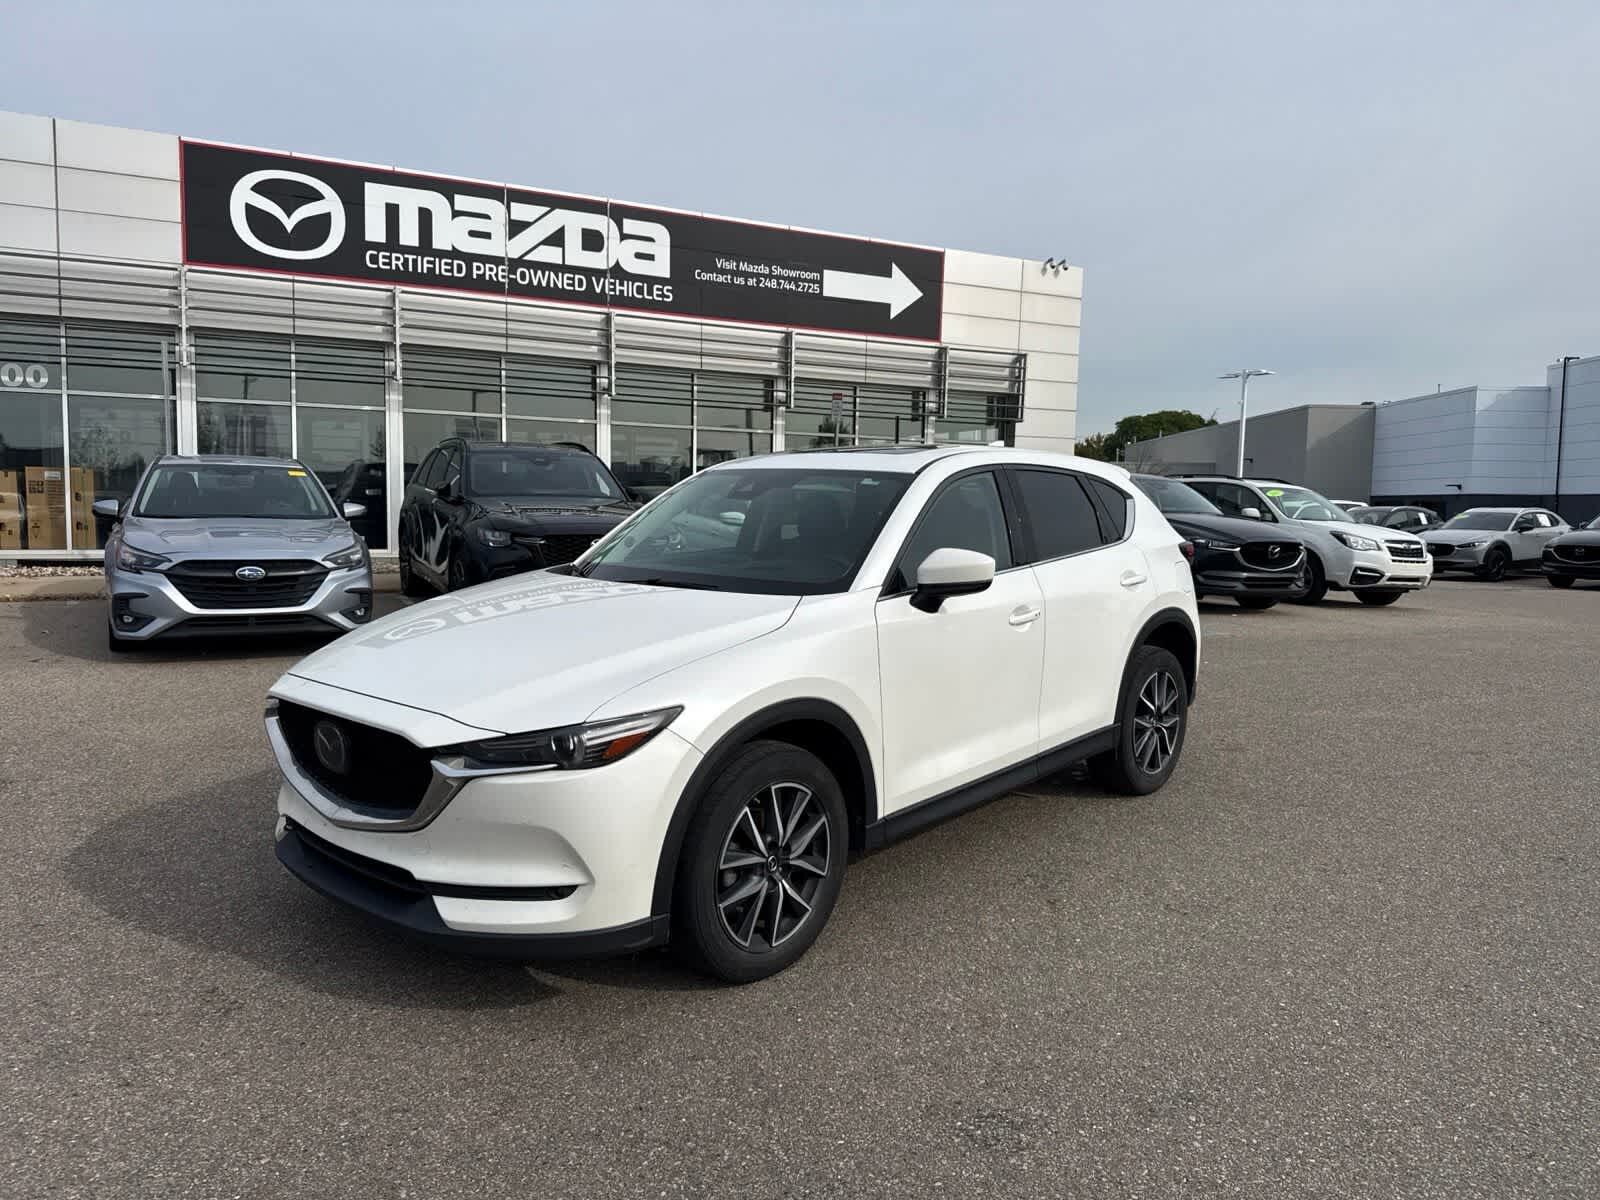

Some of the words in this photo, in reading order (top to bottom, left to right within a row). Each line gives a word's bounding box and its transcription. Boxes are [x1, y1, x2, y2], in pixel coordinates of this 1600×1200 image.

[365, 250, 467, 278] CERTIFIED
[473, 264, 587, 292] PRE-OWNED
[593, 277, 673, 302] VEHICLES
[715, 257, 737, 270] Visit
[740, 261, 769, 275] Mazda
[771, 265, 820, 280] Showroom
[694, 269, 732, 284] Contact
[733, 275, 745, 285] us
[747, 276, 757, 287] at
[759, 277, 820, 294] 248.744.2725
